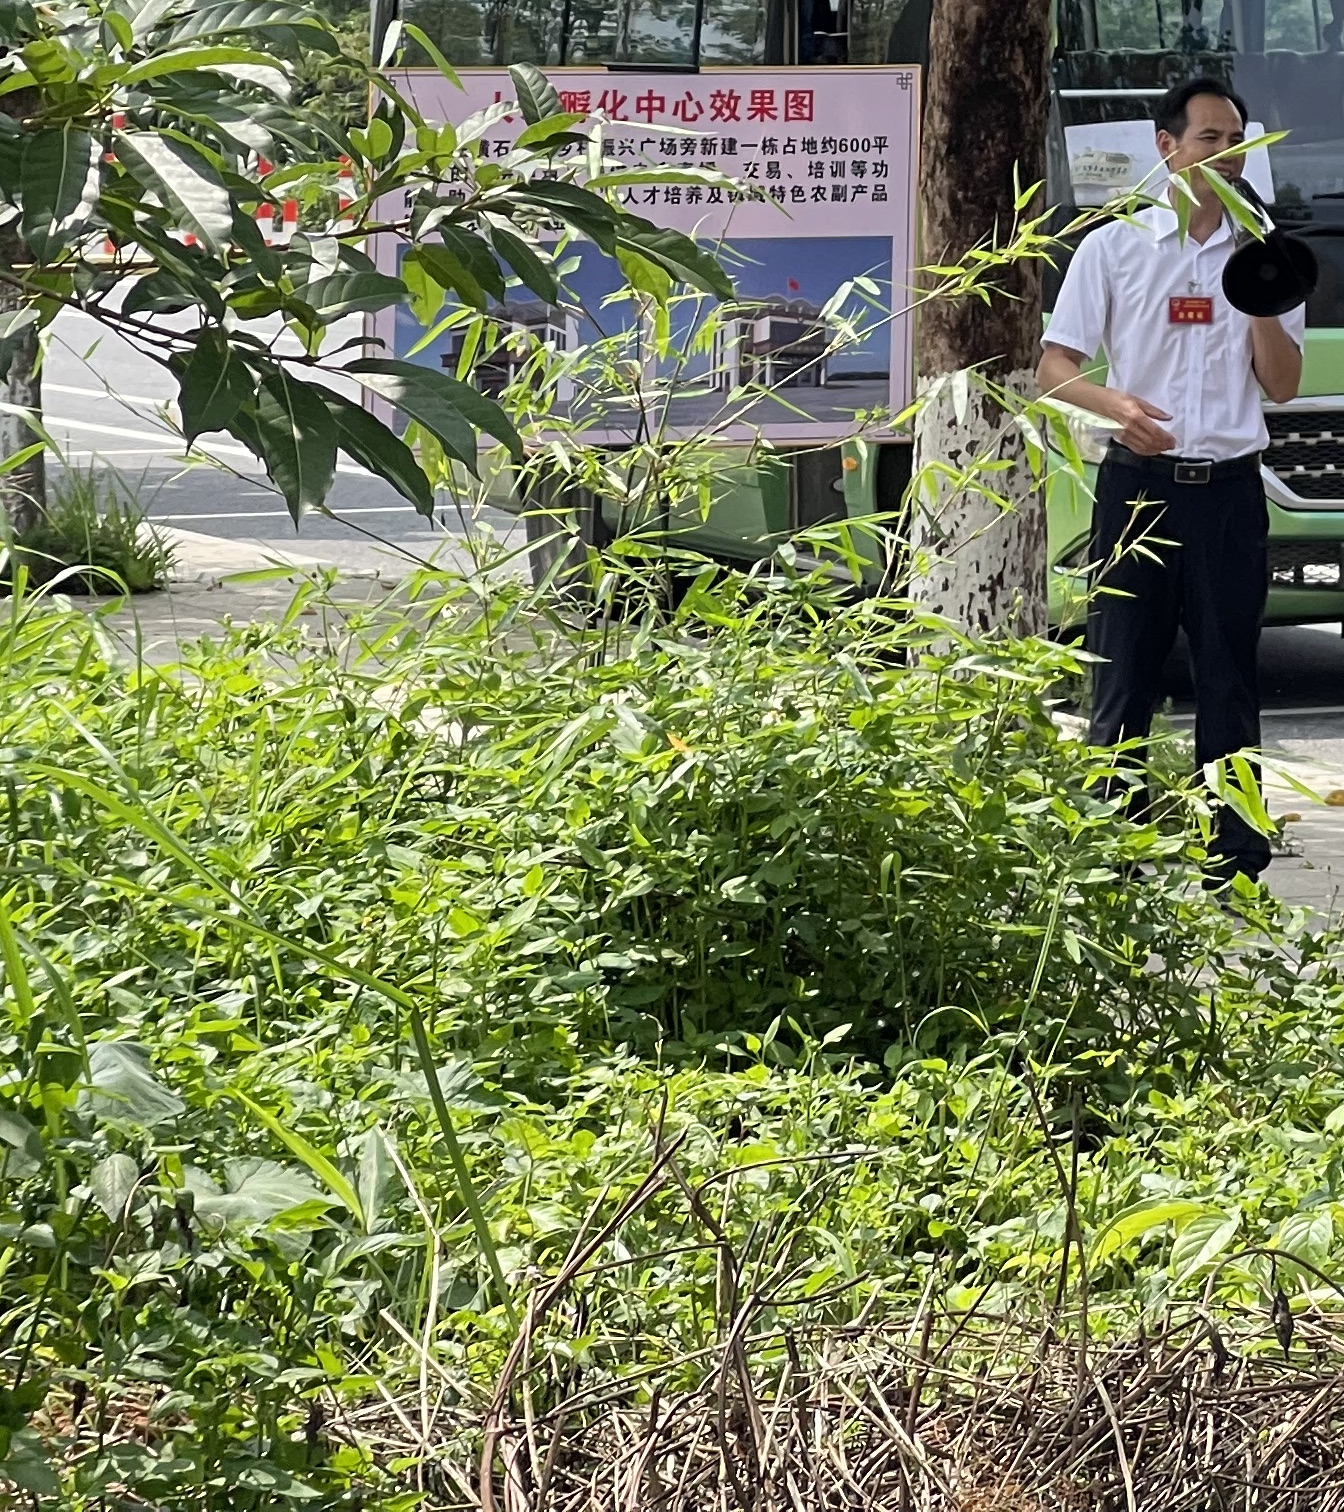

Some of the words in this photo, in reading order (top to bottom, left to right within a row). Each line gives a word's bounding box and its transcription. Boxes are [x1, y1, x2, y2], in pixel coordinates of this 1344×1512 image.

[494, 90, 814, 124] 孵化中心效果图
